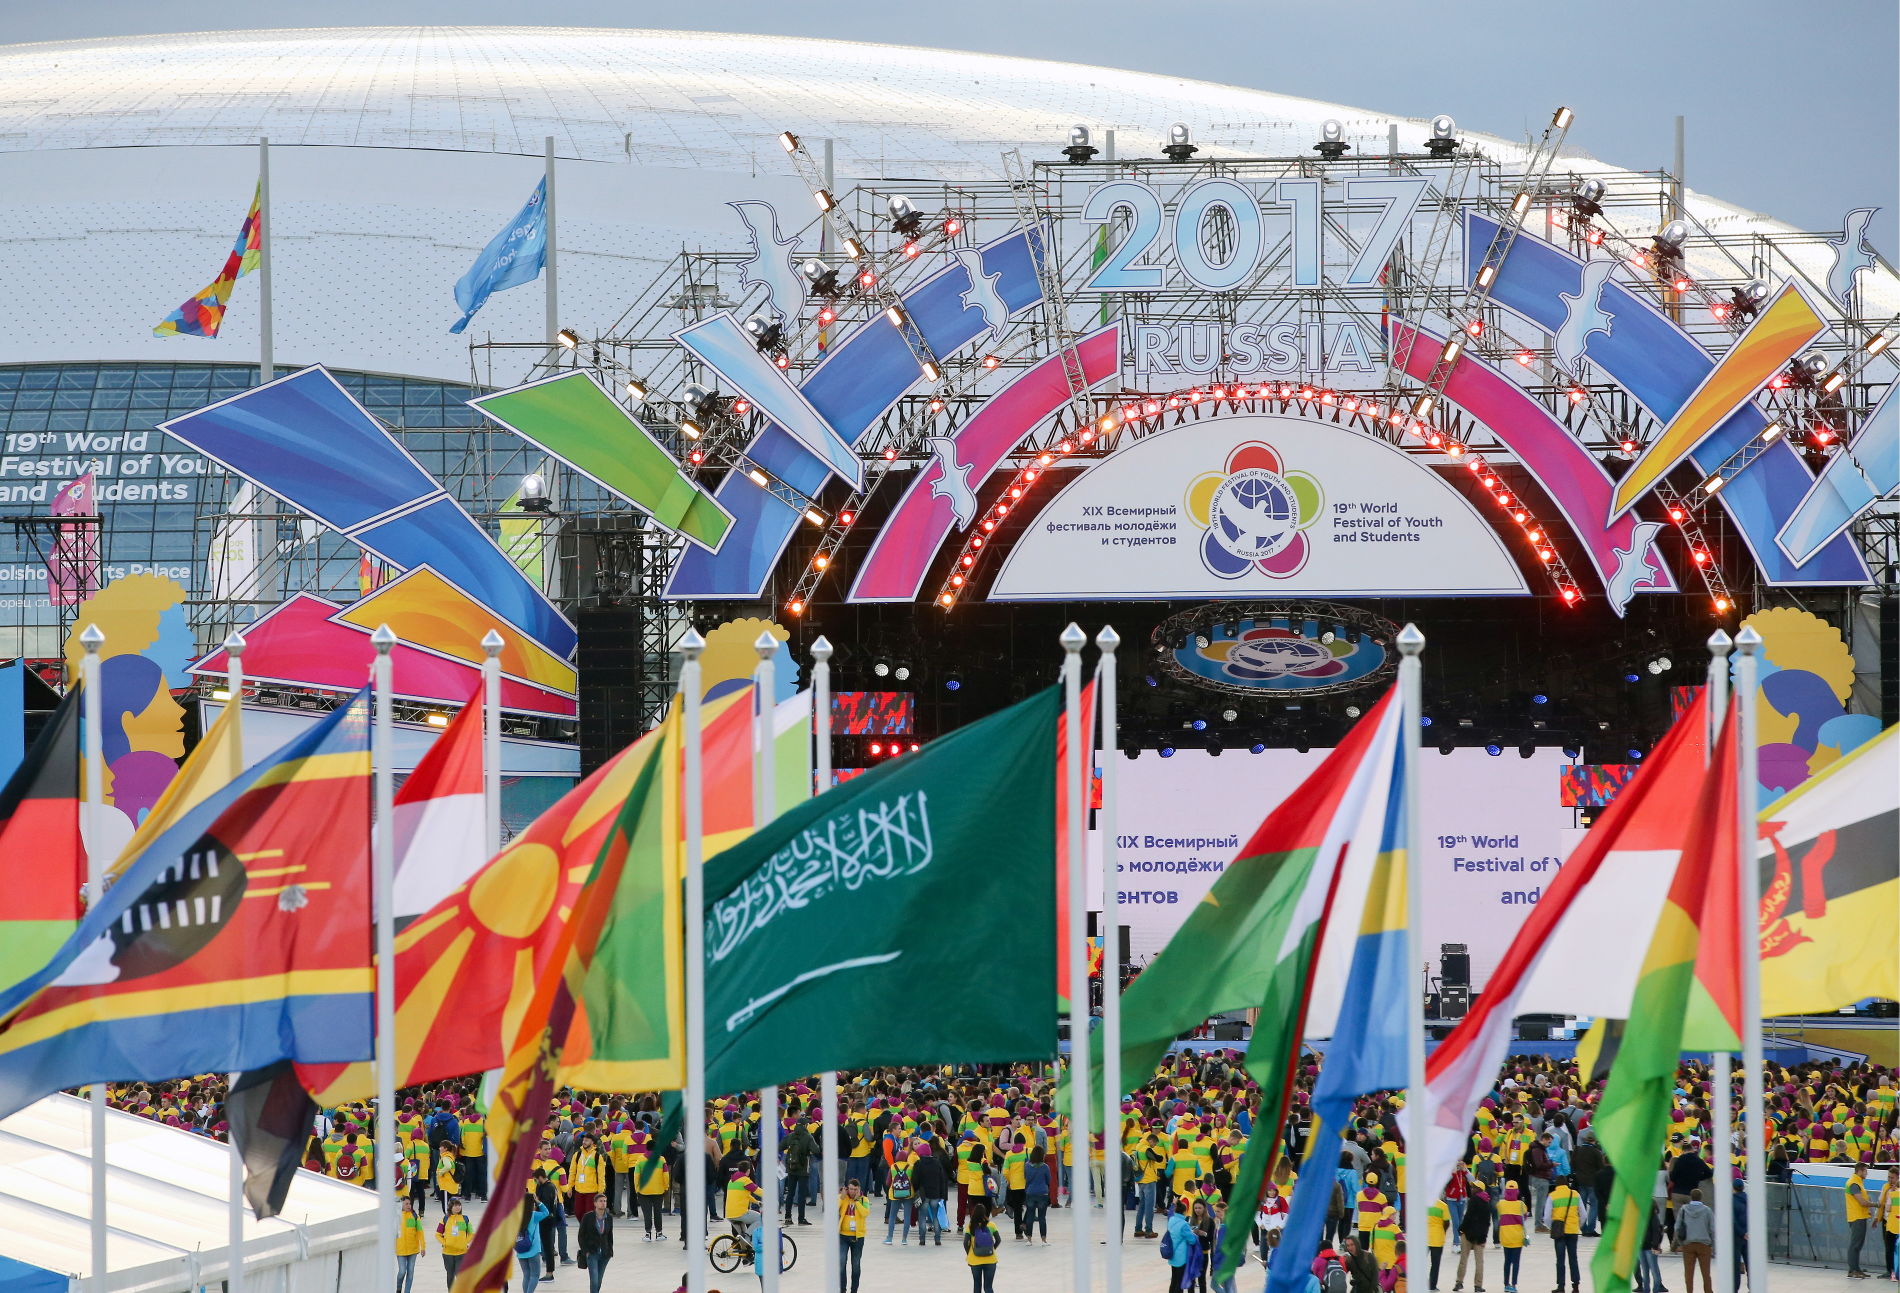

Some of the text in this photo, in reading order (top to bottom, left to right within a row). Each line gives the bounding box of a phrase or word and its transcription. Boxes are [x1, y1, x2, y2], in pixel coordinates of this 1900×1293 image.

[1080, 175, 1436, 292] 2017
[1135, 322, 1376, 375] RUSSIA
[6, 431, 149, 452] 19th World
[0, 454, 231, 477] Festival of You
[0, 479, 189, 501] and udents
[1212, 489, 1224, 513] WORLD
[1222, 472, 1248, 490] FESTIVAL
[1260, 471, 1280, 484] YOUTH
[1280, 483, 1291, 497] AND
[1288, 495, 1297, 529] STUDENTS
[1082, 505, 1177, 518] XIX Всемирный
[1333, 503, 1398, 514] 19th World
[1046, 520, 1177, 534] фестиваль молодёжи
[1333, 517, 1443, 528] Festival of Youth
[1101, 537, 1177, 547] и студентов
[1333, 531, 1420, 542] and Students
[1236, 547, 1274, 557] RUSSIA 2017
[0, 565, 48, 581] olsho
[0, 599, 32, 611] орец
[1144, 834, 1239, 851] Всемирный
[1438, 835, 1519, 849] 19th World
[1129, 858, 1224, 874] молодёжи
[1453, 857, 1525, 872] Festival
[1529, 857, 1549, 872] of
[1117, 891, 1179, 904] ентов
[1501, 887, 1541, 905] and
